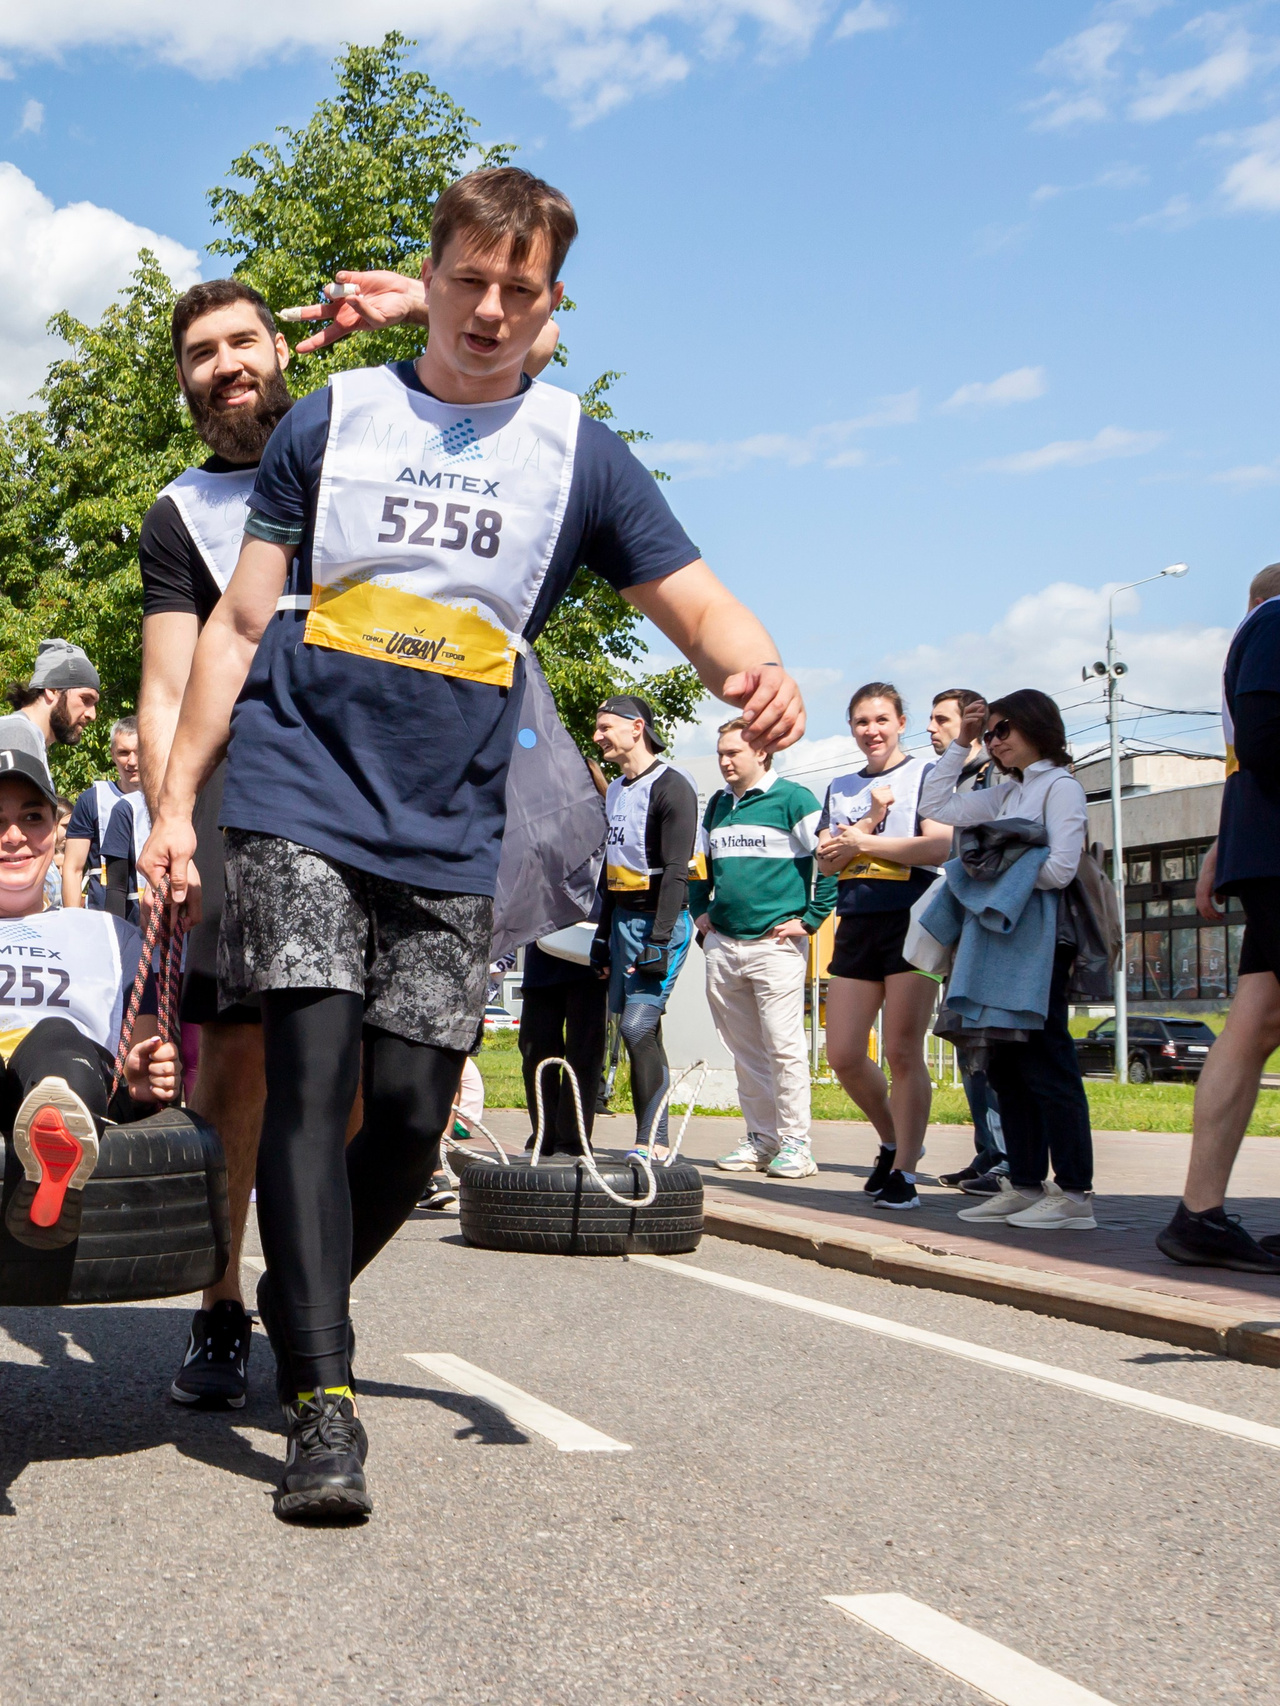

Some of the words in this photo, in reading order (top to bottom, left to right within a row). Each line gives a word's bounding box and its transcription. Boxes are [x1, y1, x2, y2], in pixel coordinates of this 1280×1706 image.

[395, 467, 501, 498] AMTEX
[377, 496, 503, 559] 5258
[385, 631, 446, 662] URBAN
[607, 826, 625, 846] 254
[709, 838, 718, 849] St
[721, 834, 767, 848] Michael
